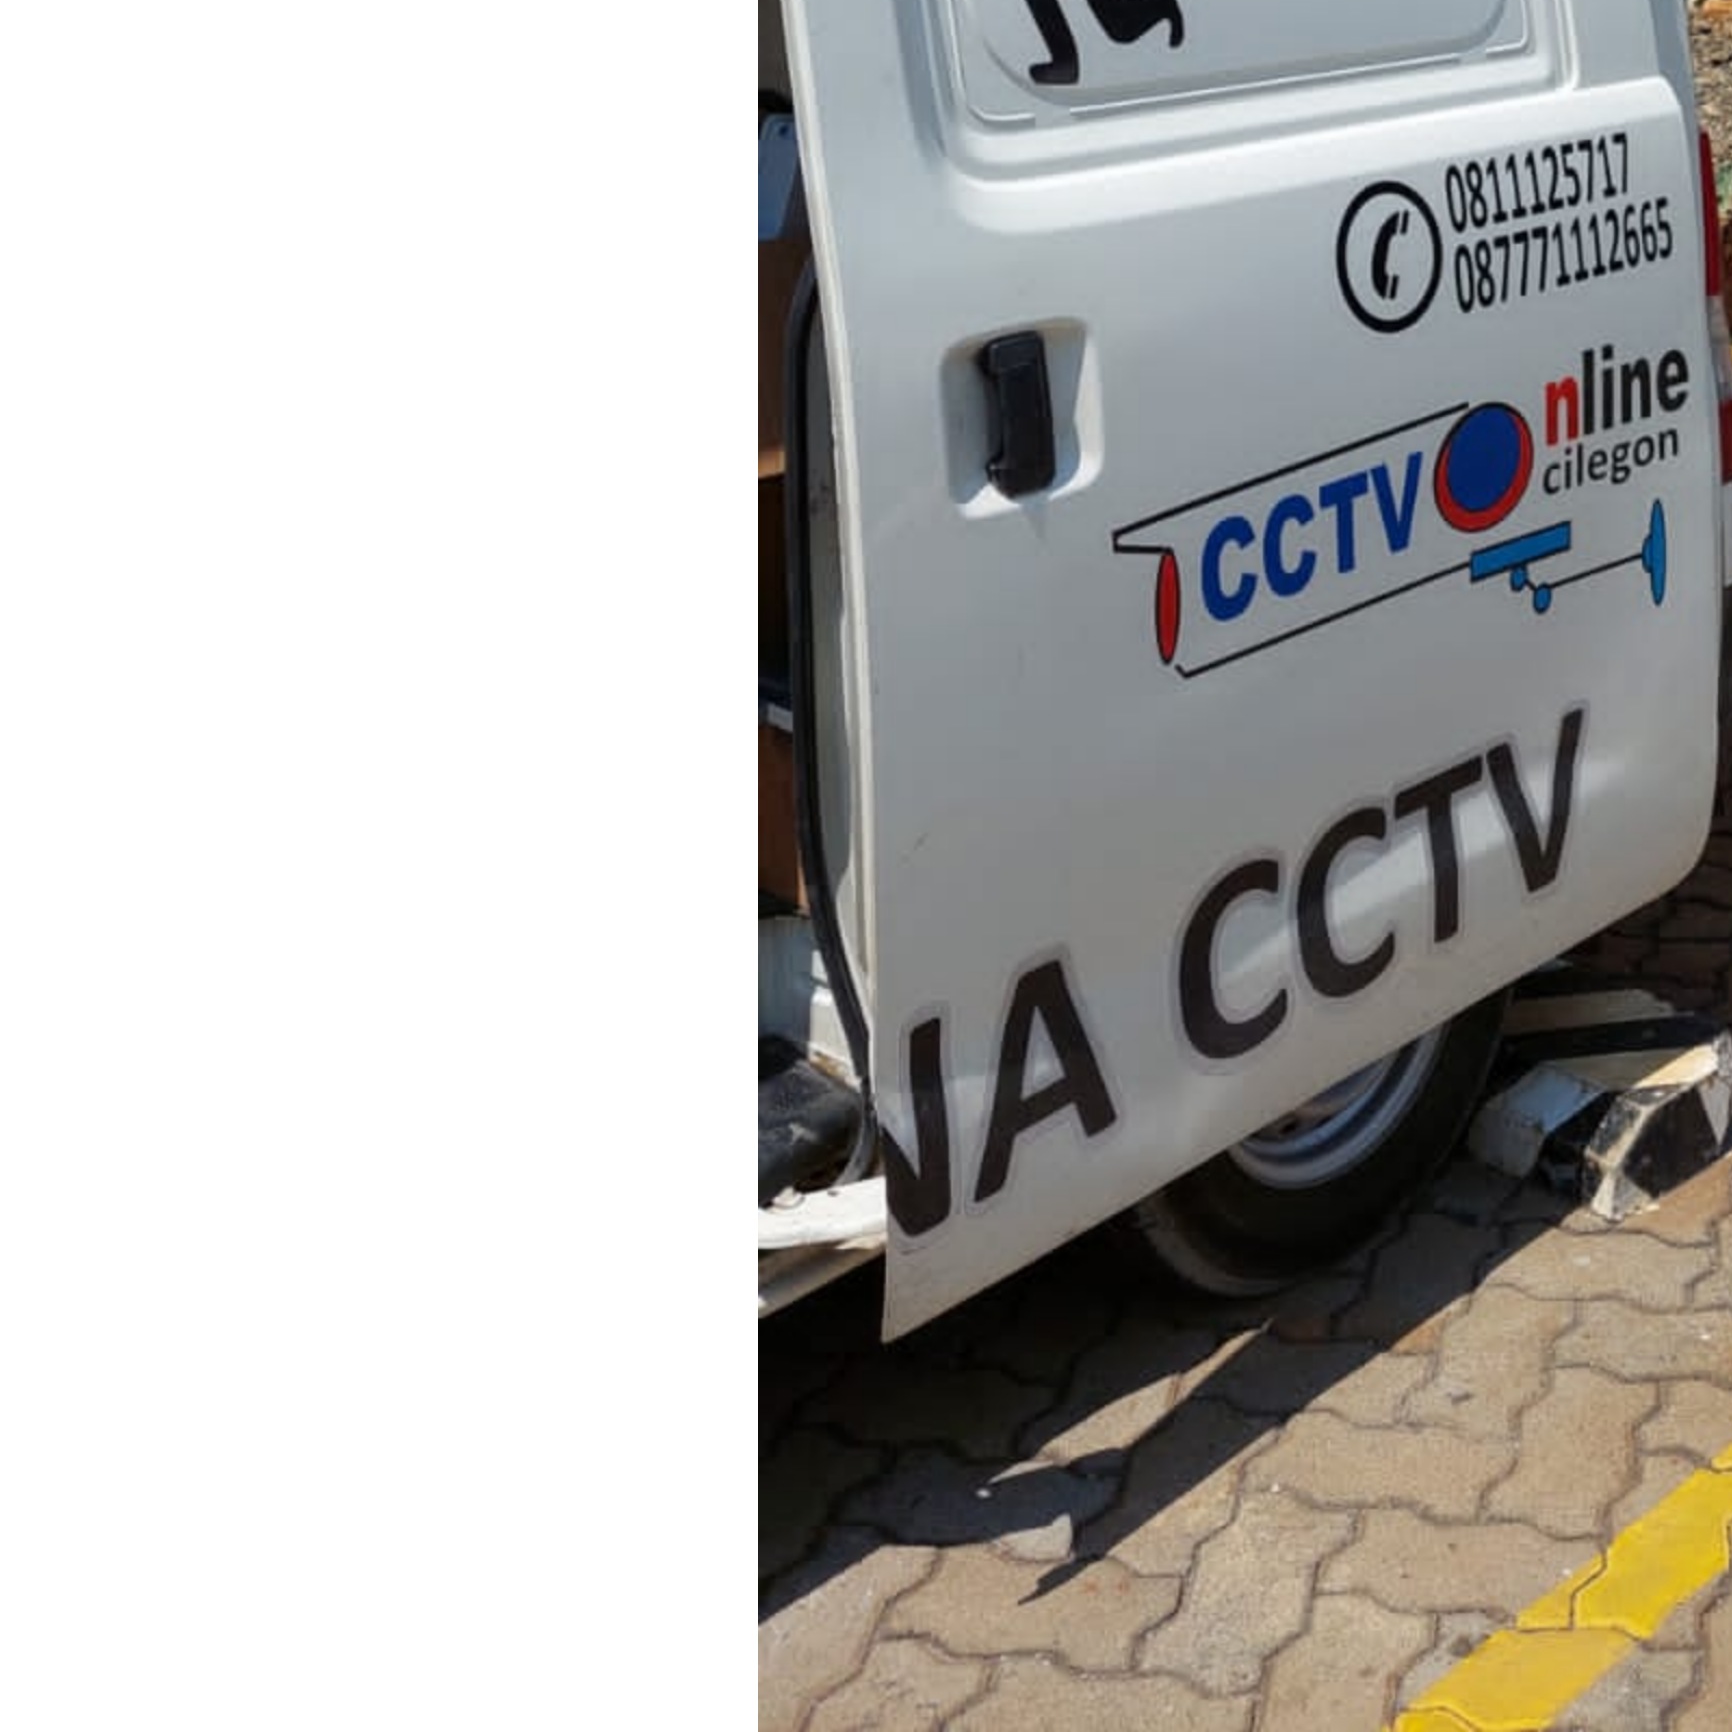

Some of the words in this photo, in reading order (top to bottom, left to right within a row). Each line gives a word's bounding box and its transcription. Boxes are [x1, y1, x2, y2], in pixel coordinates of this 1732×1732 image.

[1445, 132, 1628, 233] 0811125717
[1454, 197, 1673, 313] 087771112665
[1543, 428, 1679, 495] cilegon
[1201, 451, 1423, 622] CCTV
[1179, 709, 1583, 1059] CCTV
